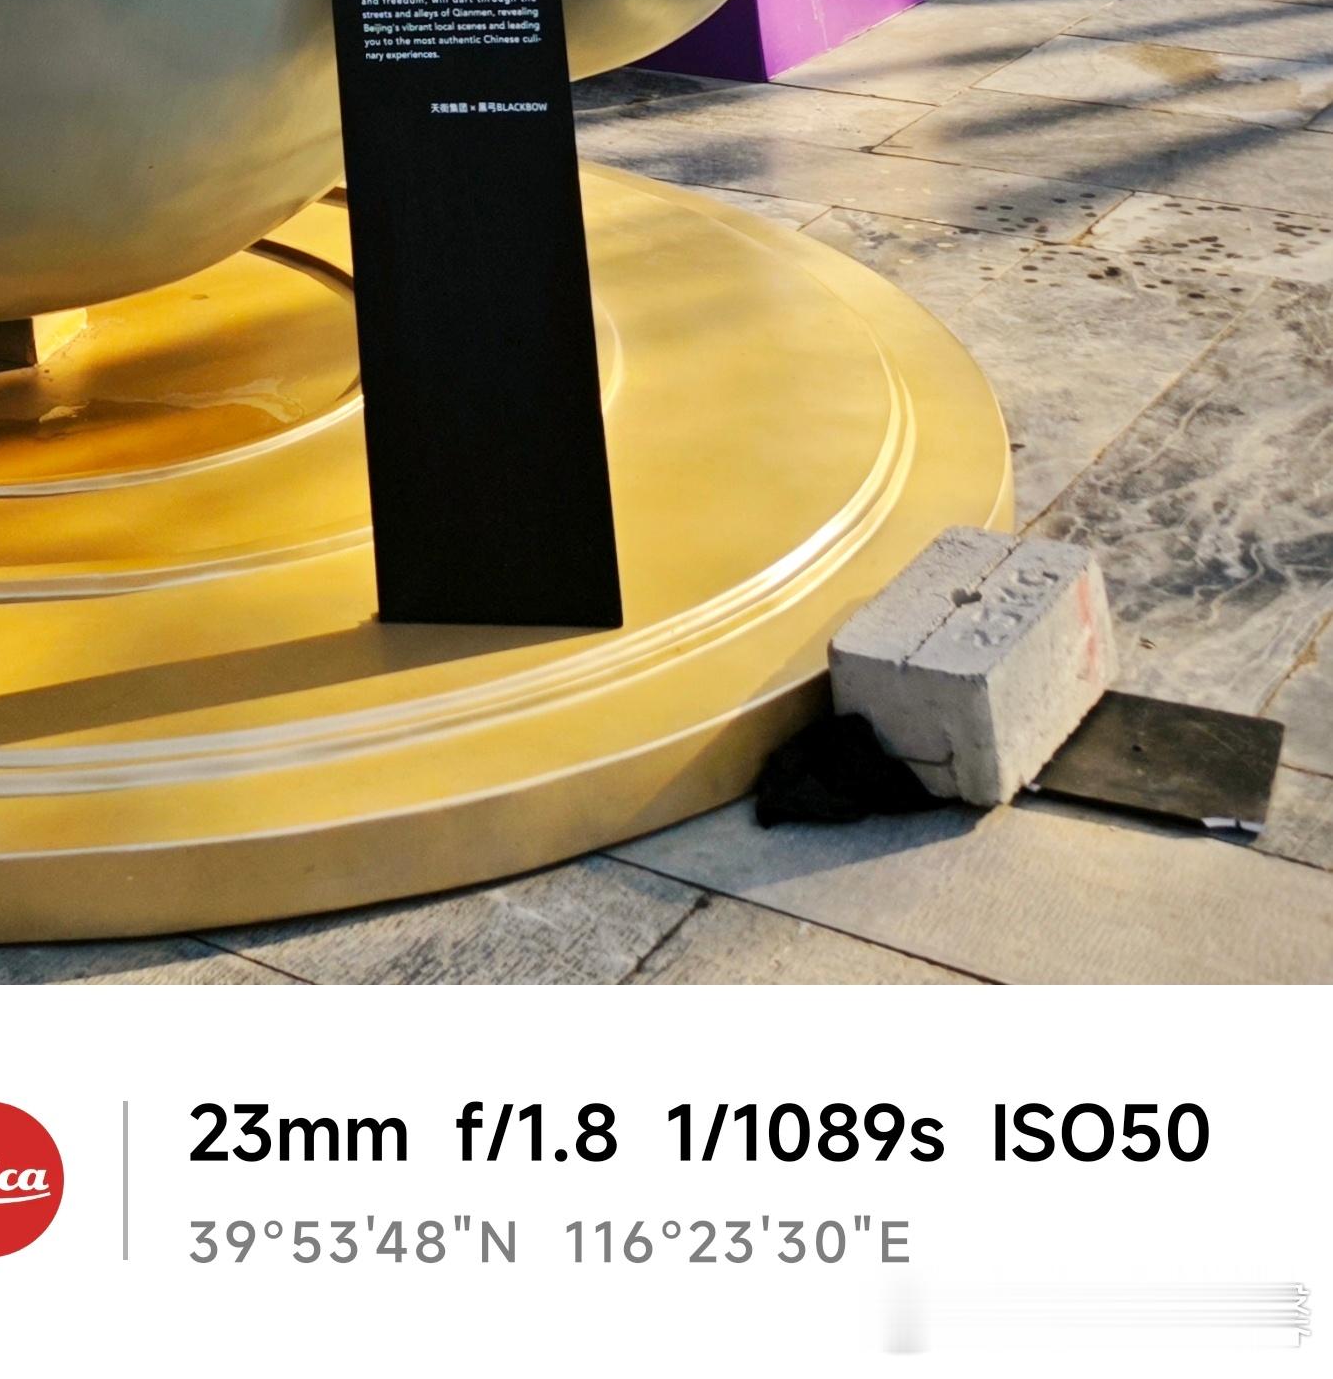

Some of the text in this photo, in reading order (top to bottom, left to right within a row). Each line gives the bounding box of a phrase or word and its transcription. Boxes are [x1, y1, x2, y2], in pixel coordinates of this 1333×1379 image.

[362, 7, 539, 19] streets and alleys of Qianmen, revealing
[363, 24, 400, 35] Beijing's
[402, 23, 432, 32] vibrant
[434, 23, 454, 31] local
[489, 21, 505, 30] and
[507, 21, 540, 32] leading
[364, 35, 542, 48] you to the most authentic Chinese culi-
[366, 51, 440, 62] nary experiences.
